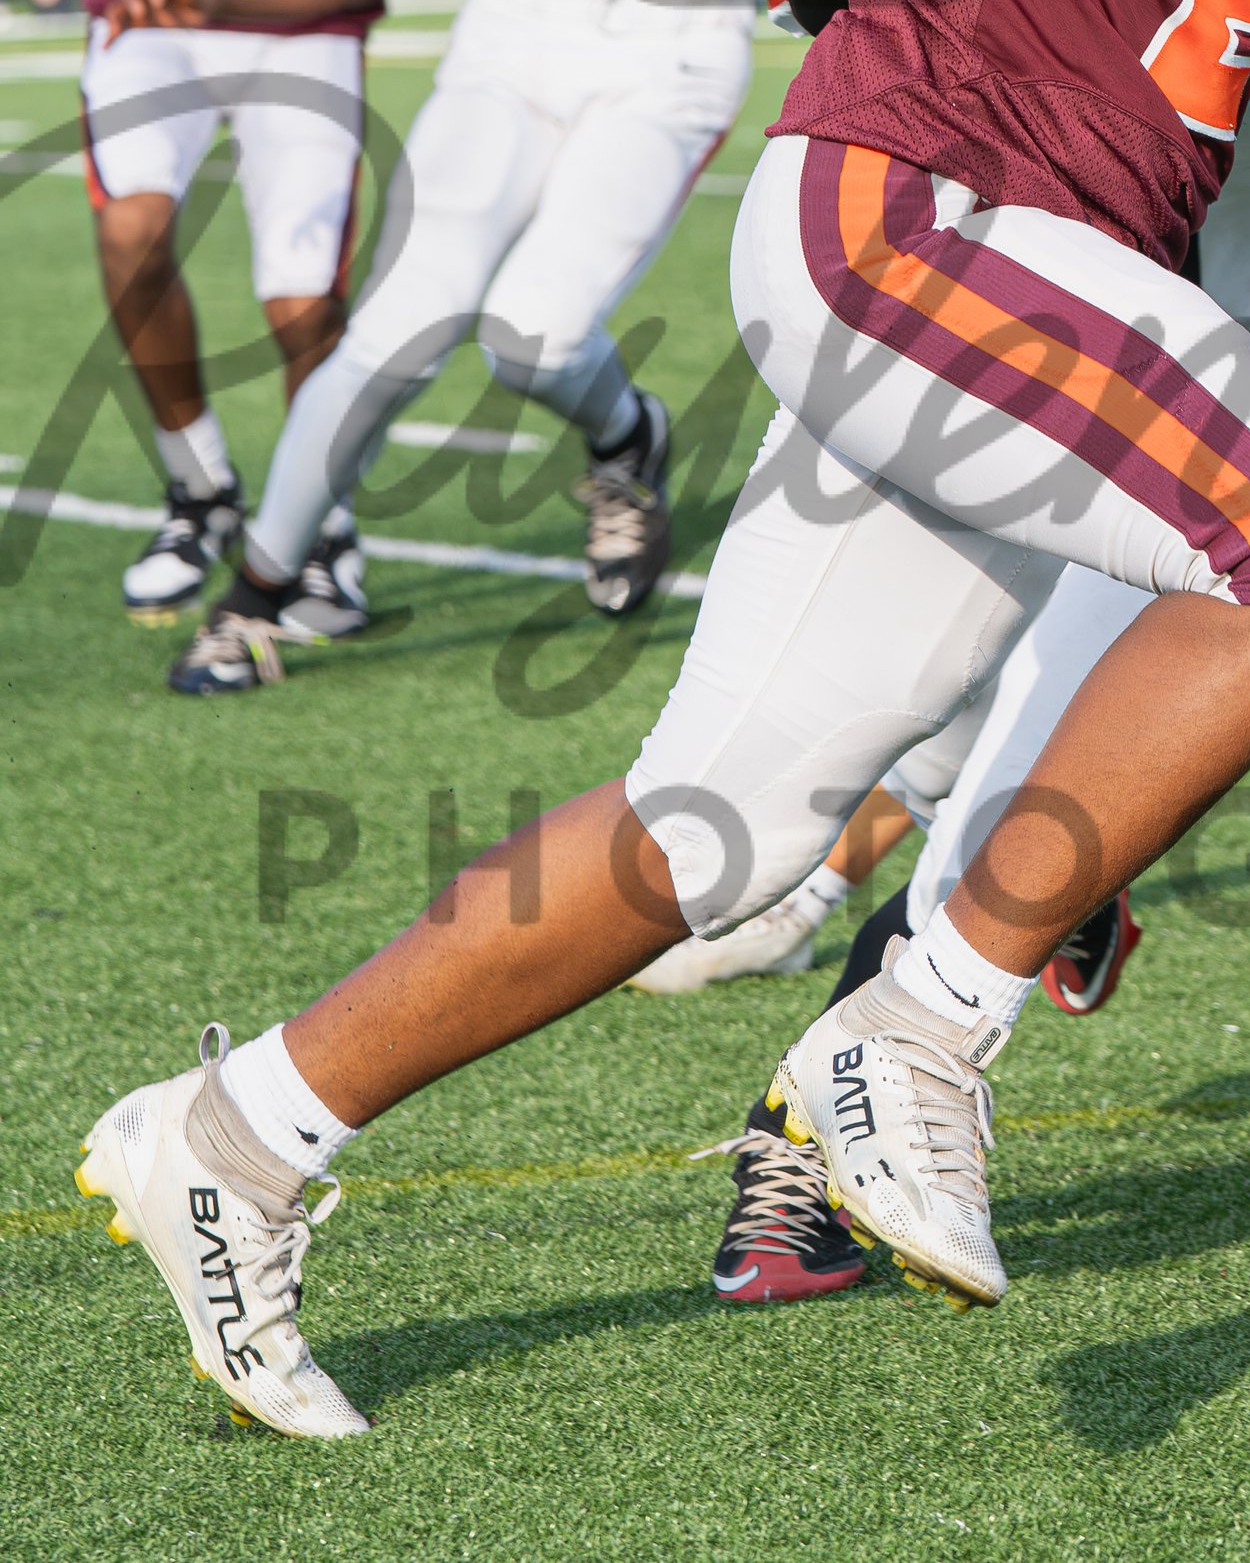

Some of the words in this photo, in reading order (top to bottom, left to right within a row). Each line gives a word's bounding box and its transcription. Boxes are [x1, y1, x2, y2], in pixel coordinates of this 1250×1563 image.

[832, 1041, 897, 1188] BATT
[972, 1029, 998, 1061] BATTLE
[188, 1187, 265, 1382] BATTLE
